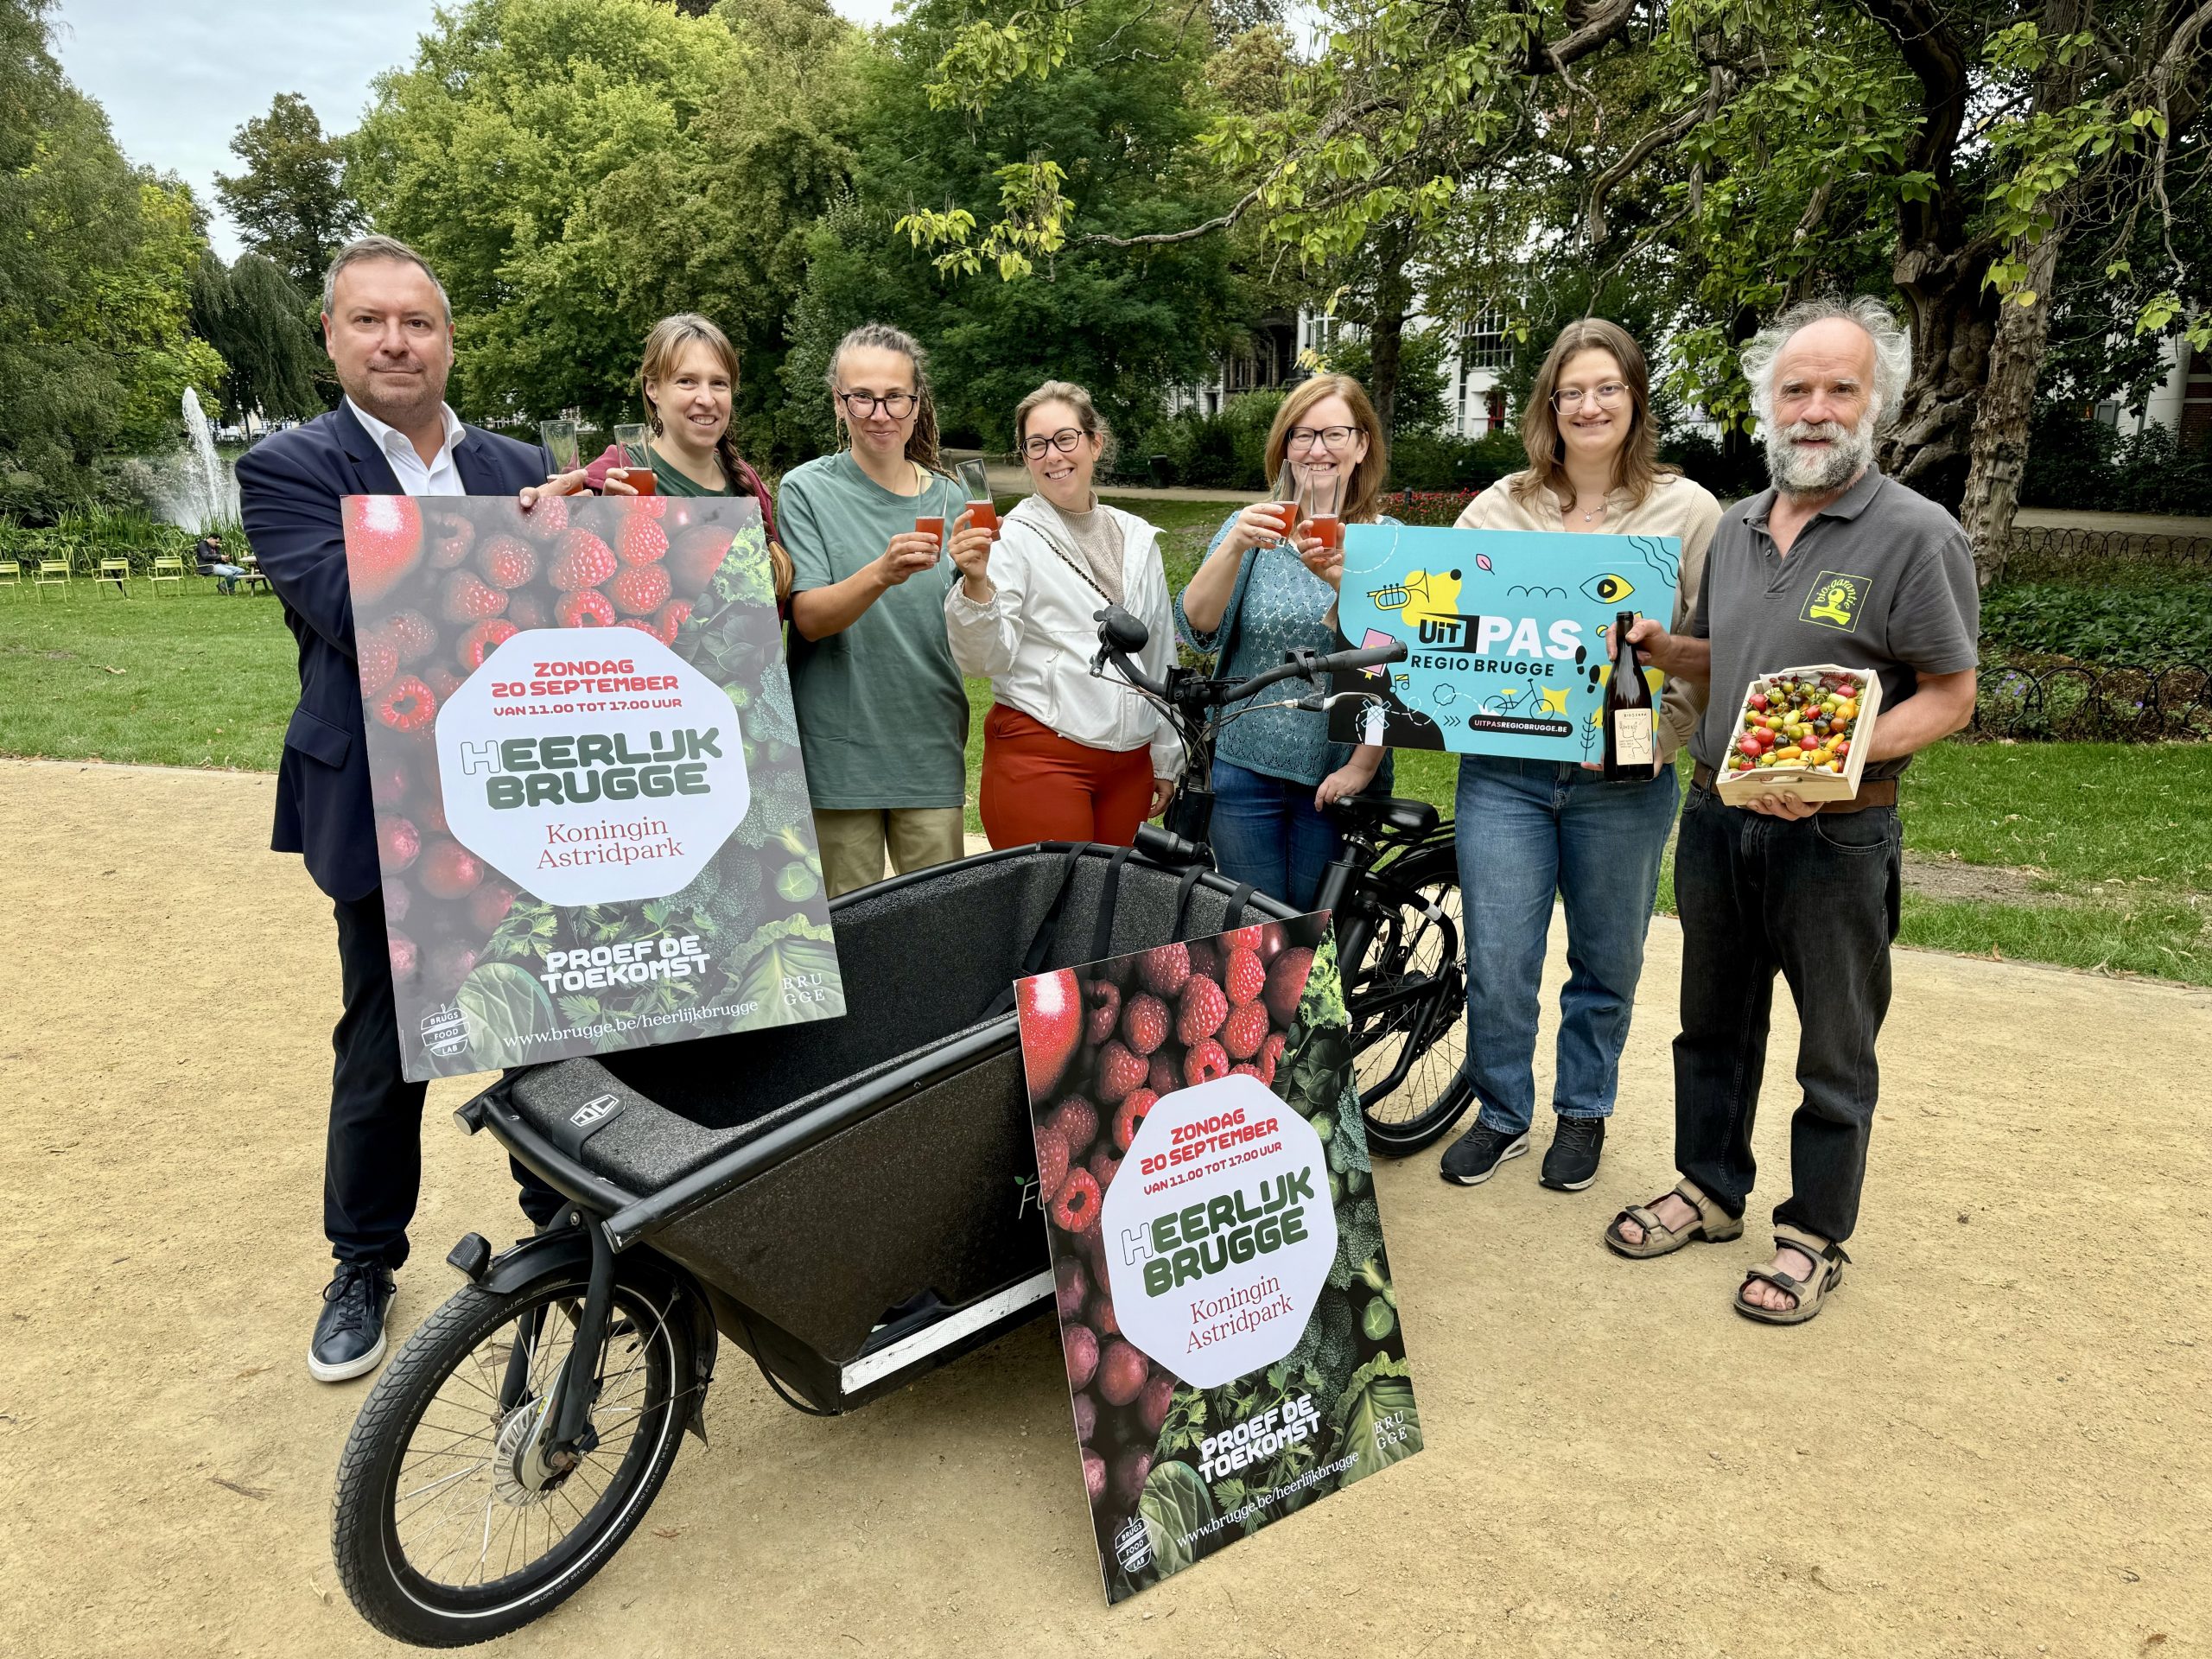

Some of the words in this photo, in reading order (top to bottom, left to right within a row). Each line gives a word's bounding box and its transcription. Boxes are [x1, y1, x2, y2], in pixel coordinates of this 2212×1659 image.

[1418, 619, 1462, 644] UiT
[1475, 615, 1583, 660] PAS
[533, 659, 634, 677] ZONDAG
[1410, 654, 1470, 671] REGIO
[1473, 658, 1555, 677] BRUGGE
[491, 682, 526, 698] 20
[531, 675, 679, 696] SEPTEMBER
[493, 706, 526, 716] VAN
[529, 703, 574, 715] 11.00
[576, 702, 607, 713] TOT
[609, 700, 649, 711] 17.00
[651, 698, 682, 709] UUR
[1473, 719, 1568, 734] UITPASREGIOBRUGGE.BE
[461, 727, 722, 775] HEERLIJK
[486, 762, 711, 810] BRUGGE
[546, 817, 669, 844] Koningin
[537, 837, 684, 870] Astridpark
[545, 940, 654, 973] PROEF
[658, 935, 702, 958] DE
[540, 954, 710, 994] TOEKOMST
[782, 973, 823, 990] BRU
[783, 988, 825, 1007] GGE
[429, 1012, 459, 1026] BRUGS
[434, 1028, 459, 1040] FOOD
[503, 1001, 759, 1048] www.brugge.be/heerlijkbrugge
[442, 1045, 458, 1055] LAB
[1170, 1108, 1245, 1146] ZONDAG
[1141, 1154, 1166, 1175] 20
[1169, 1118, 1280, 1166] SEPTEMBER
[1144, 1179, 1168, 1195] VAN
[1170, 1168, 1204, 1187] 11.00
[1205, 1160, 1227, 1174] TOT
[1228, 1150, 1259, 1166] 17.00
[1259, 1141, 1282, 1157] UUR
[1121, 1166, 1314, 1266] HEERLIJK
[1143, 1206, 1308, 1298] BRUGGE
[1190, 1275, 1281, 1324] Koningin
[469, 1298, 524, 1340] PICK-UP
[1186, 1294, 1294, 1354] Astridpark
[1200, 1408, 1279, 1462] PROEF
[1281, 1393, 1314, 1423] DE
[1373, 1410, 1404, 1434] BRU
[1376, 1427, 1408, 1450] GGE
[1198, 1411, 1321, 1484] TOEKOMST
[1177, 1452, 1359, 1548] www.brugge.be/heerlijkbrugge
[1122, 1522, 1142, 1541] BRUGS
[1125, 1539, 1144, 1556] FOOD
[1133, 1557, 1145, 1569] LAB
